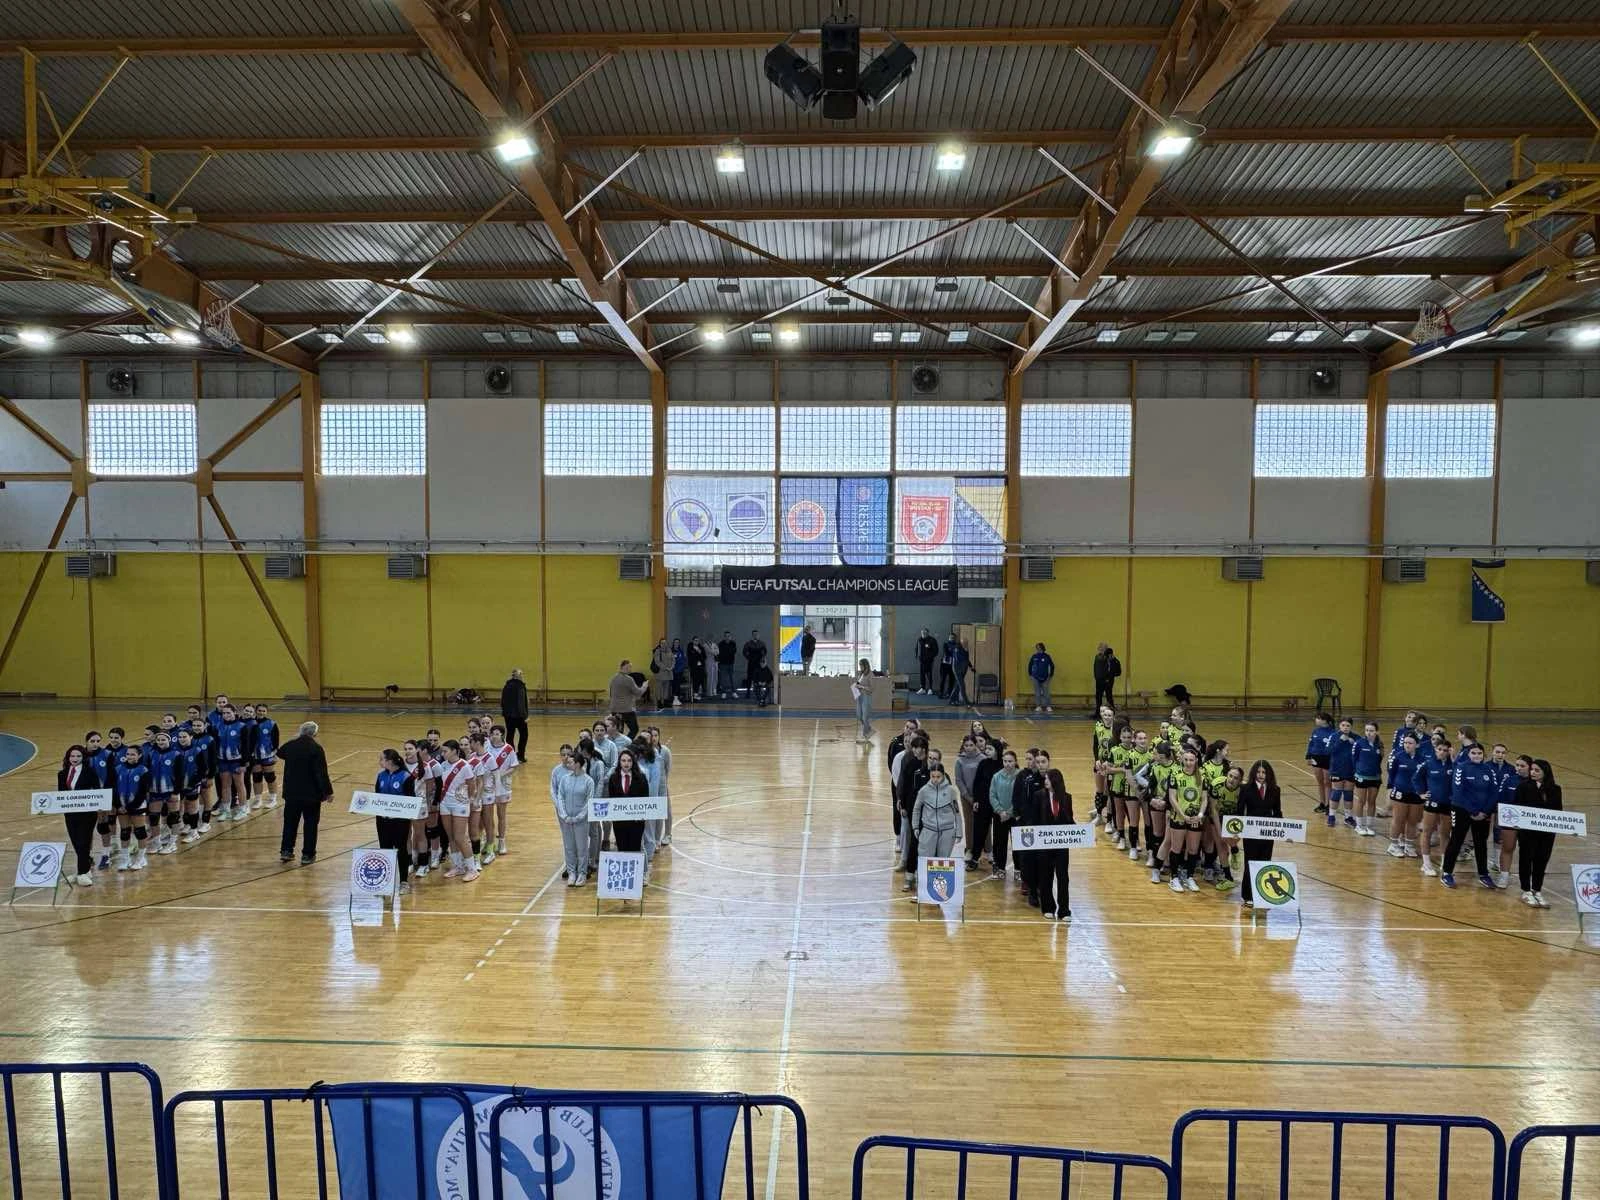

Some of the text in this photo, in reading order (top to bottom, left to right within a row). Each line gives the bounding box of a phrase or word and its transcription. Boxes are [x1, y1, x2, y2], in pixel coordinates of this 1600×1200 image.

[730, 579, 949, 591] UEFA FUTSAL CHAMPIONS LEAGUE
[629, 803, 658, 811] LEOTAR
[1539, 813, 1585, 824] MAKARSKA
[1531, 820, 1575, 831] MAKARSKA
[1038, 829, 1054, 838] ŽRK
[1044, 837, 1082, 845] LJUBUŠKI
